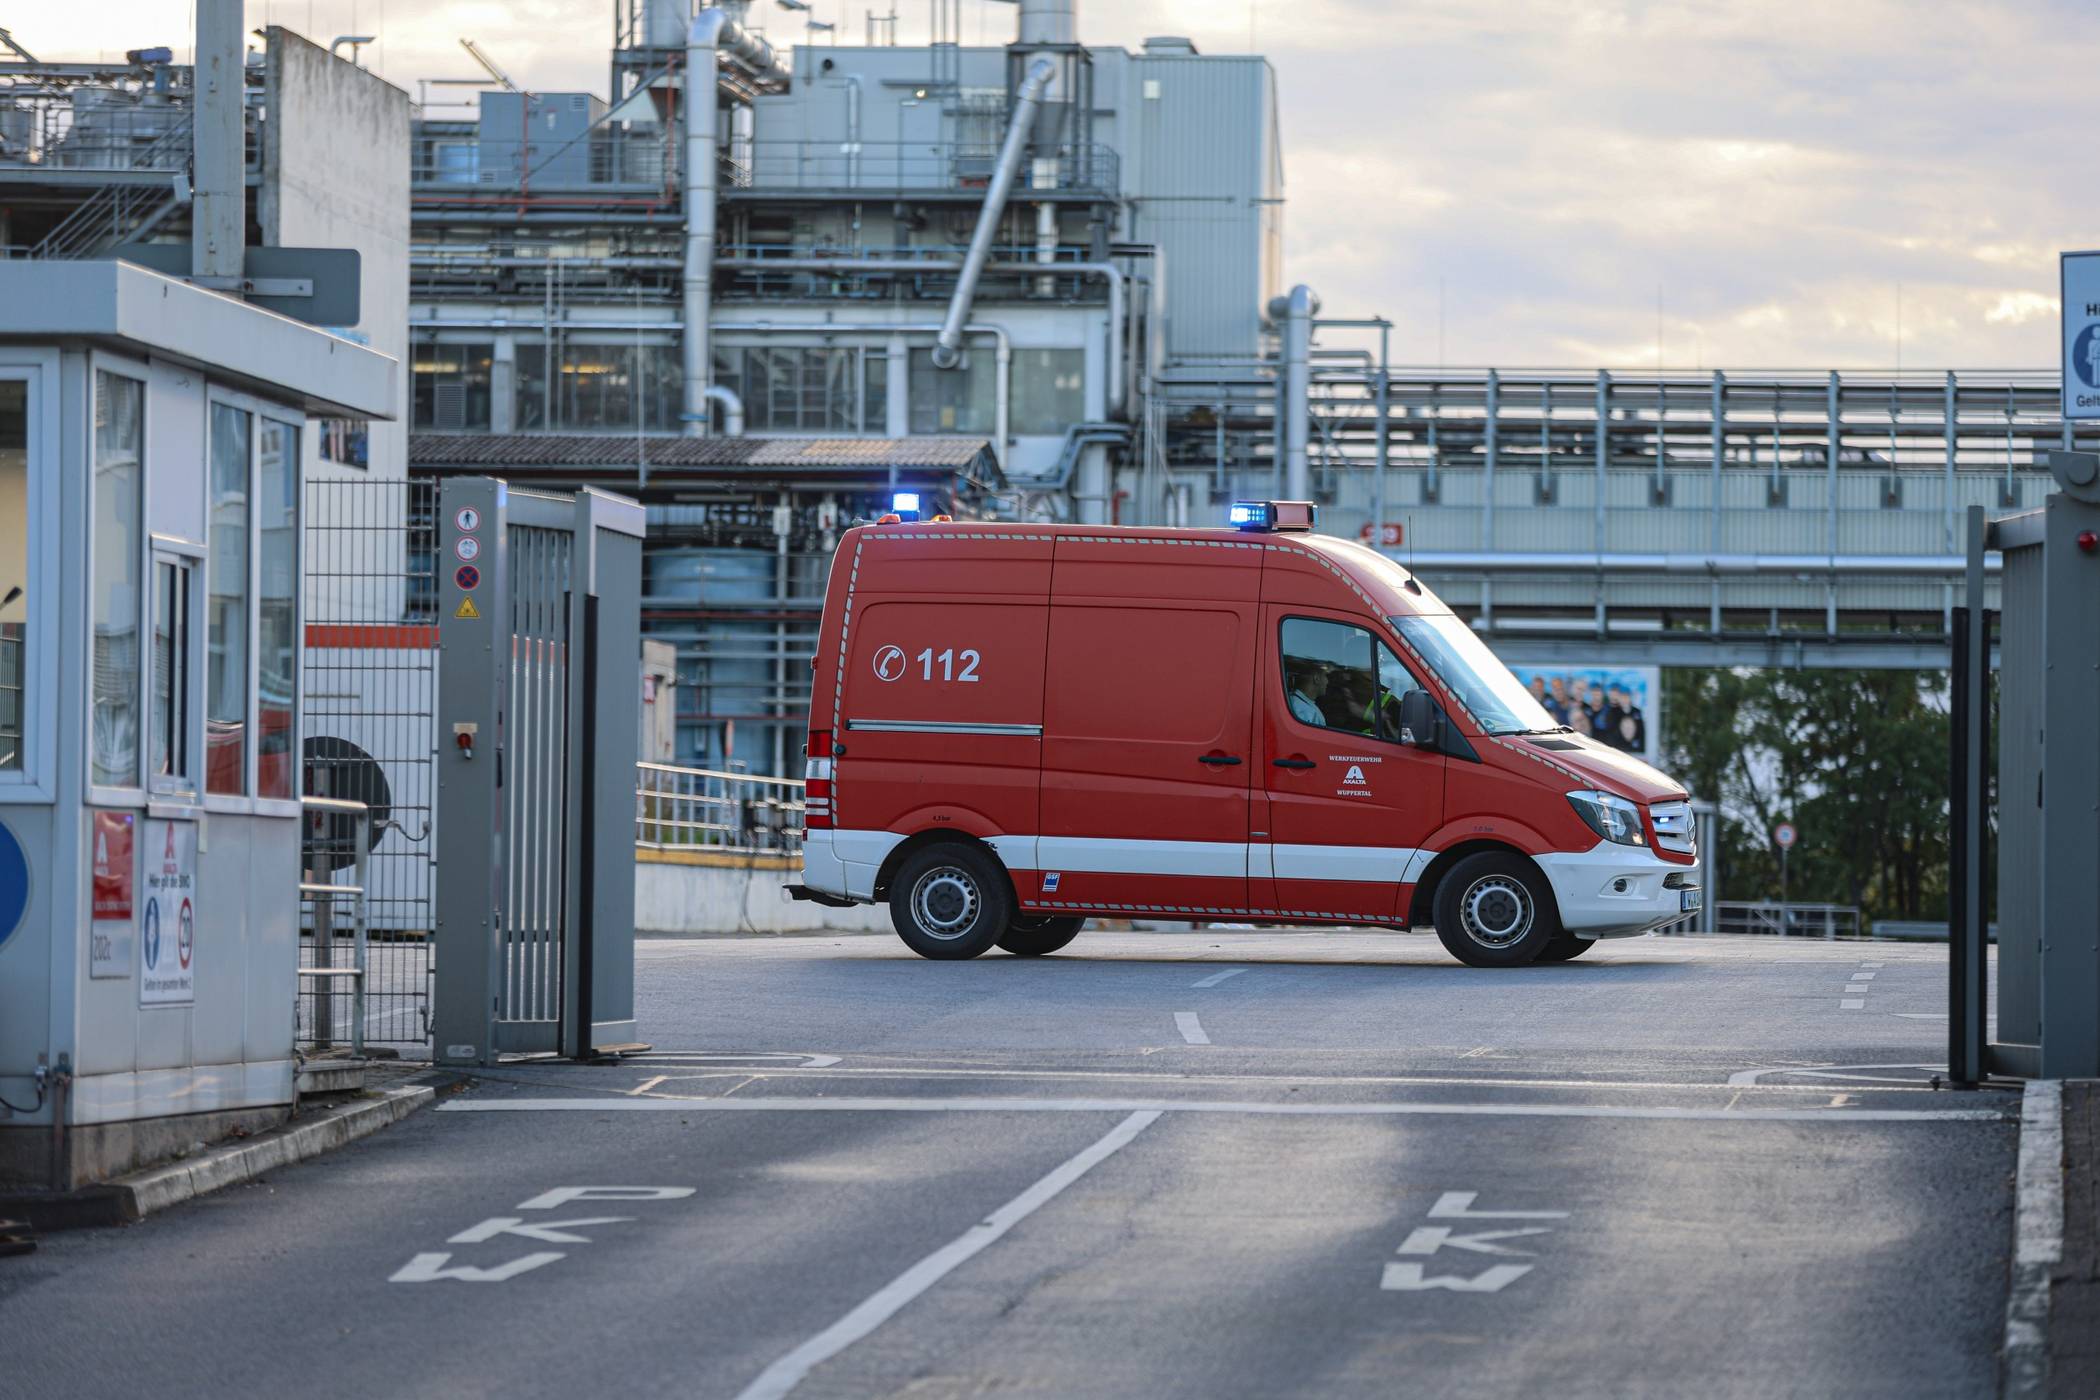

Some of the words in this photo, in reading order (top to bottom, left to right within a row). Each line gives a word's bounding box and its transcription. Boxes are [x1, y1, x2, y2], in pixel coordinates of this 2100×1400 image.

[917, 648, 980, 681] 112
[1328, 755, 1382, 763] WERKFEUERWEHR
[1337, 789, 1372, 797] WUPPERTAL
